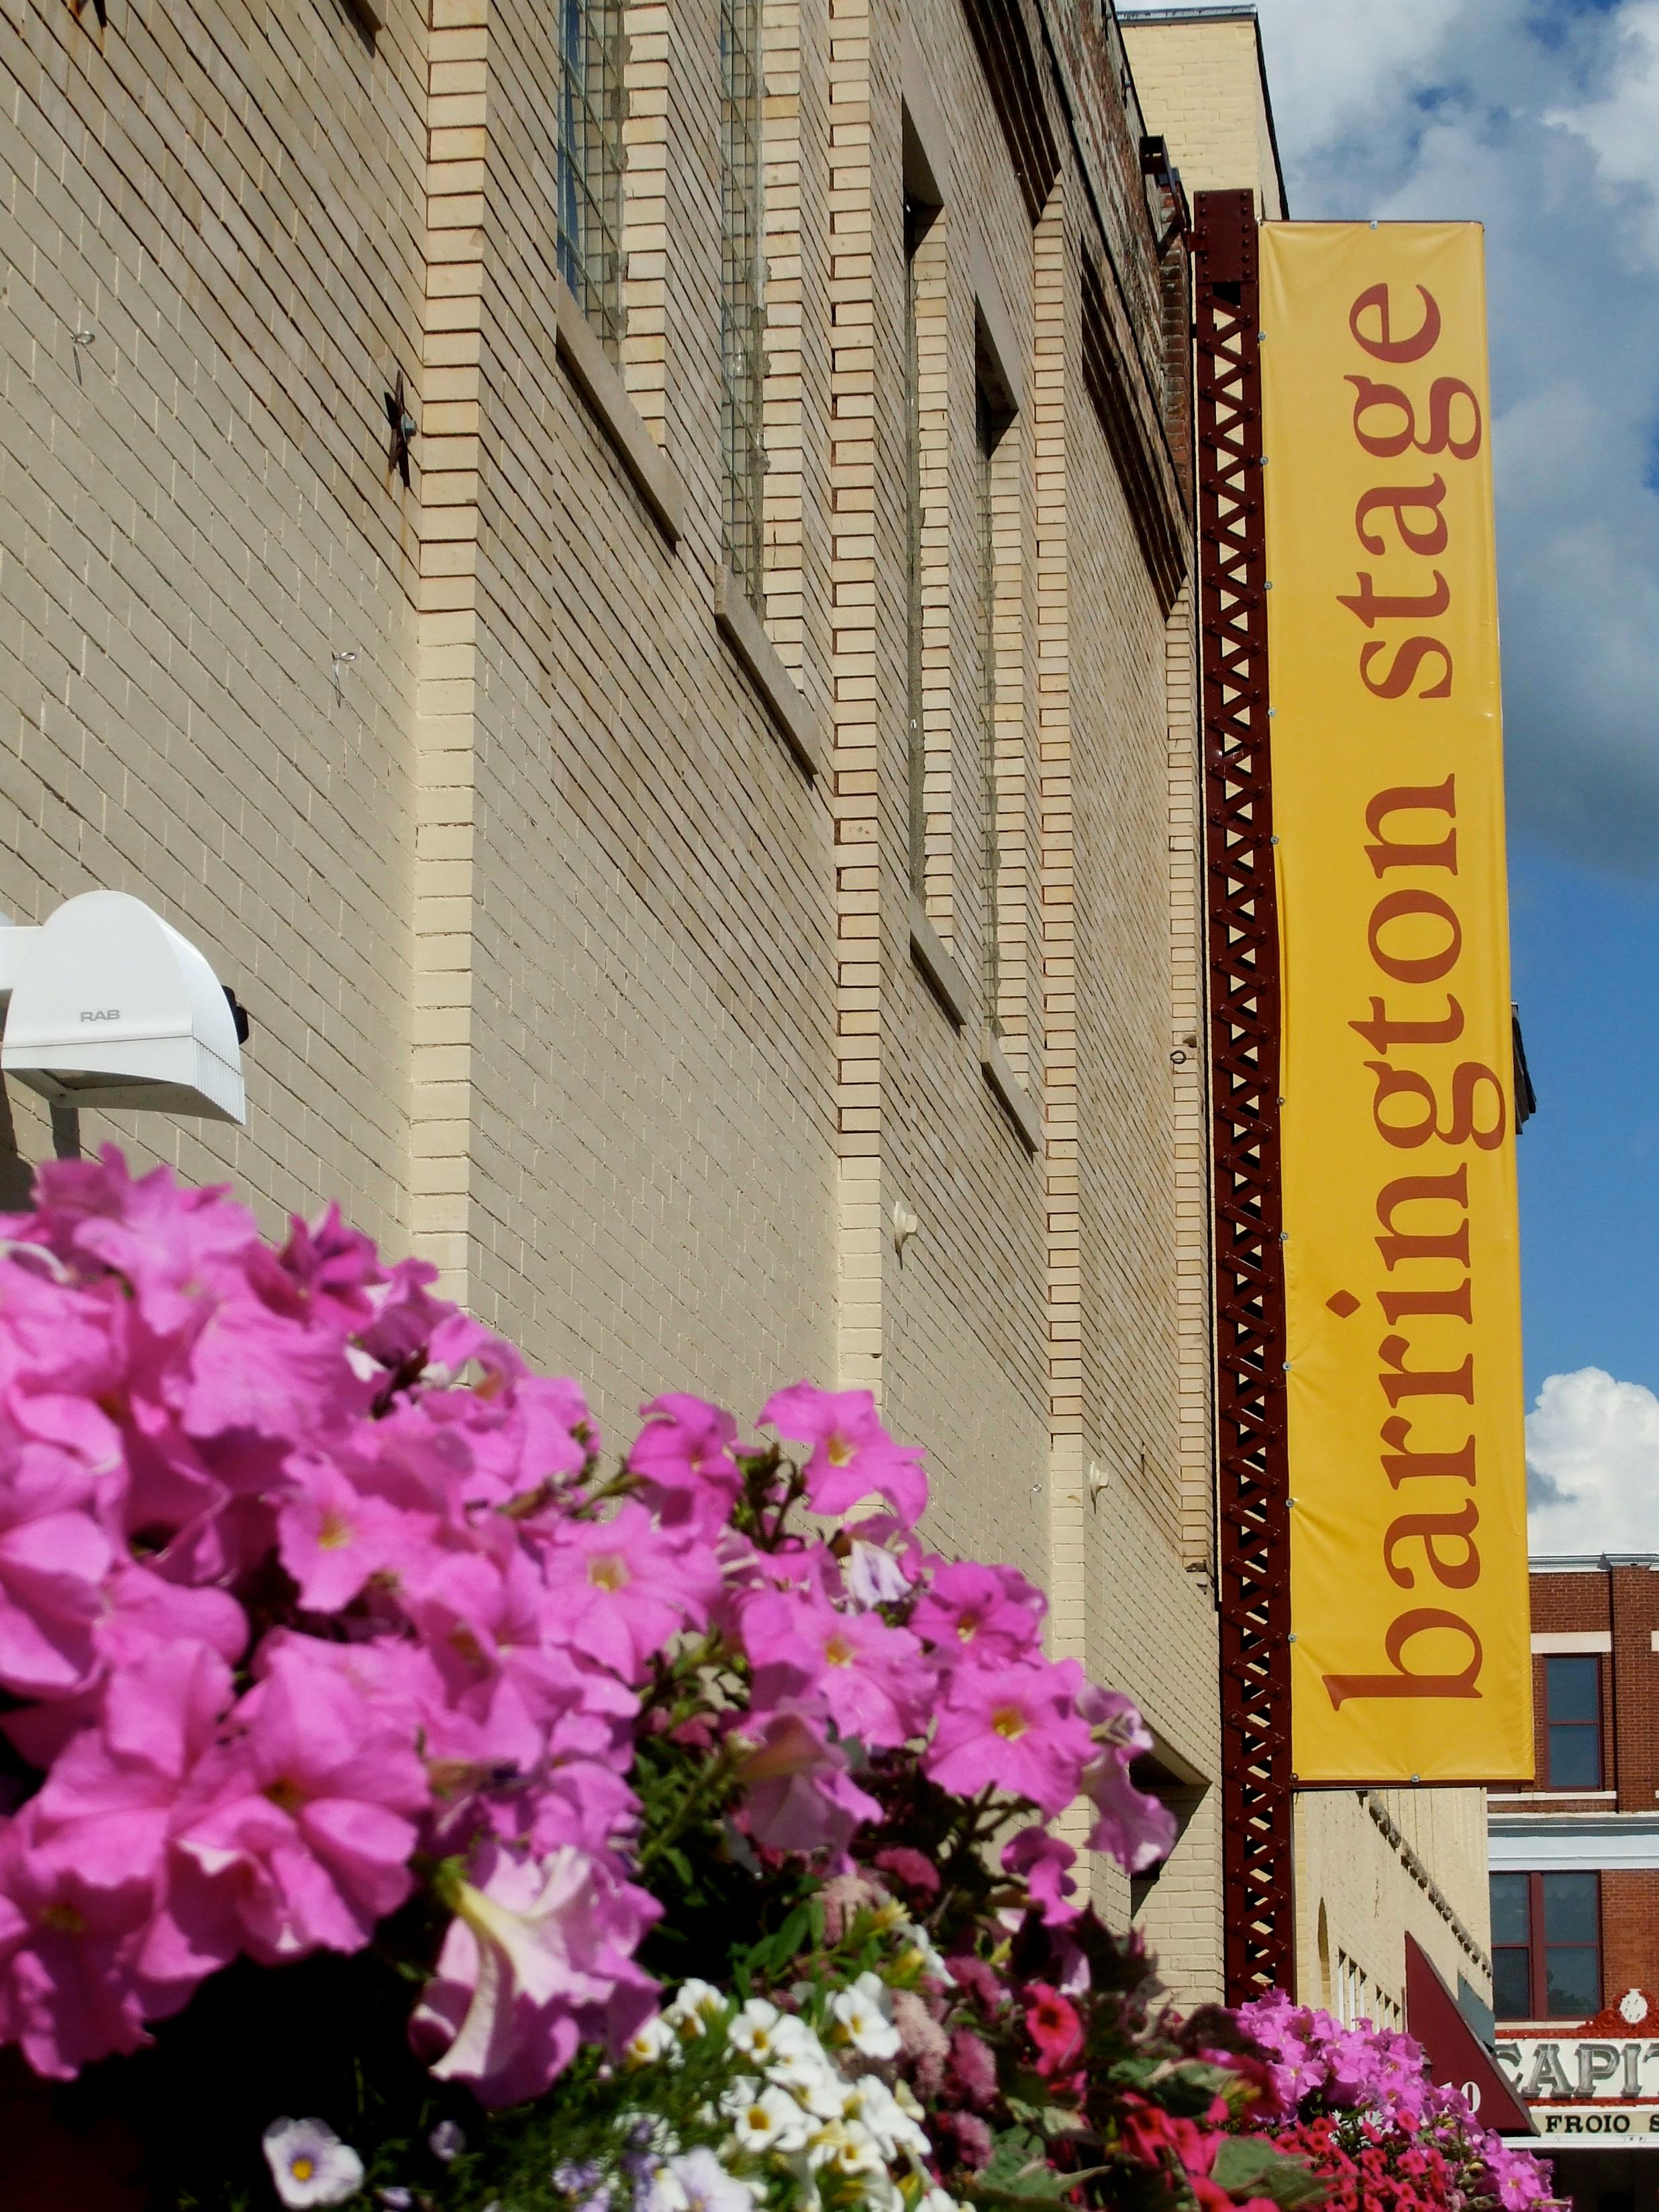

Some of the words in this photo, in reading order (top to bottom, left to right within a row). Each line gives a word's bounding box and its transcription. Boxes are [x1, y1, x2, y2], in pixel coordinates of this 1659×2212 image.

[1336, 282, 1481, 700] stage
[81, 1009, 119, 1022] RAB
[1321, 772, 1506, 1713] barrington
[1545, 2114, 1631, 2133] FROIO
